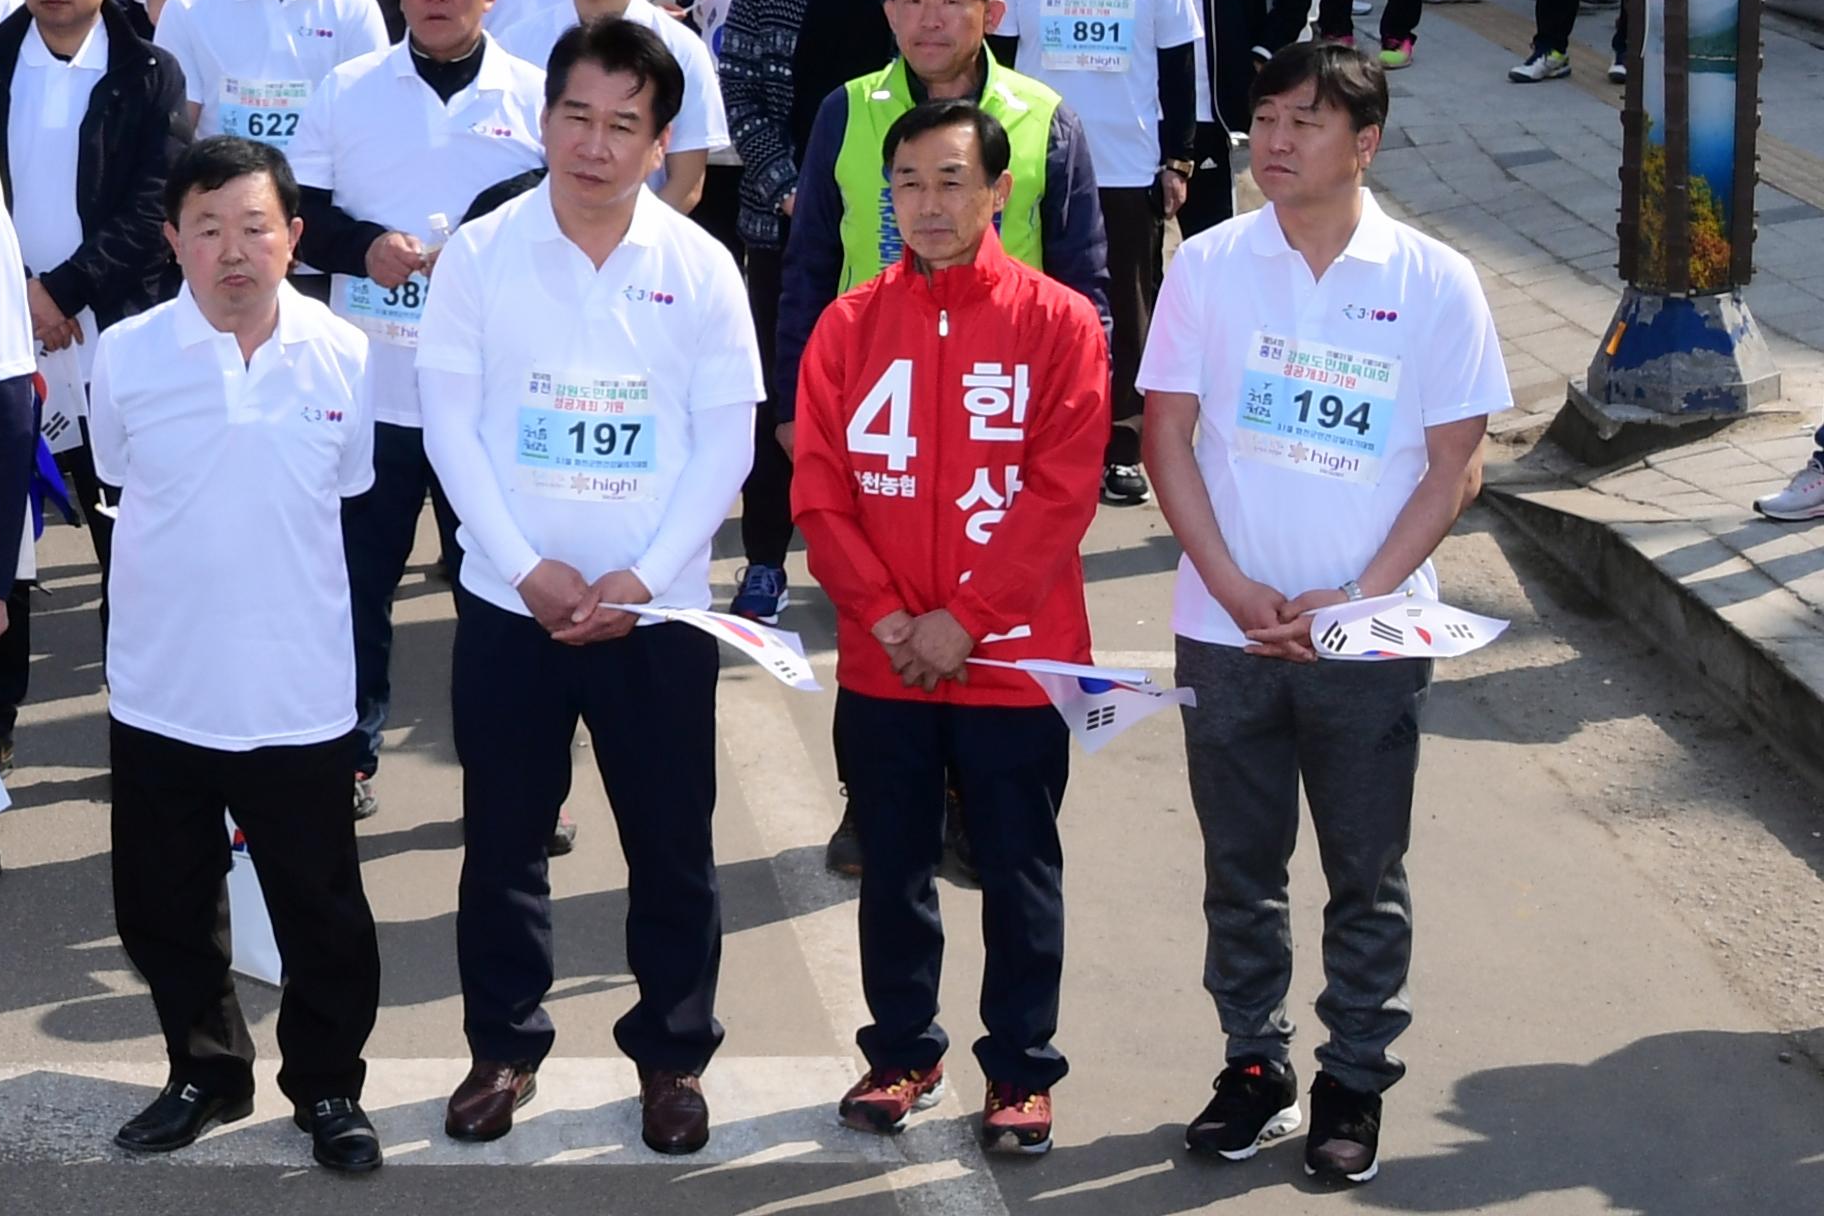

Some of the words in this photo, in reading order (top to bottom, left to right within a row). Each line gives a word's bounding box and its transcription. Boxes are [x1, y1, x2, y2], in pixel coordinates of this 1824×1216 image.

[1073, 20, 1120, 43] 891
[248, 112, 300, 137] 622
[382, 281, 429, 309] 38
[1331, 377, 1358, 390] 기원
[603, 400, 624, 413] 기원
[846, 358, 918, 472] 4
[1293, 389, 1372, 436] 194
[568, 420, 642, 457] 197
[955, 361, 1031, 546] 한상
[853, 470, 917, 498] 천농협
